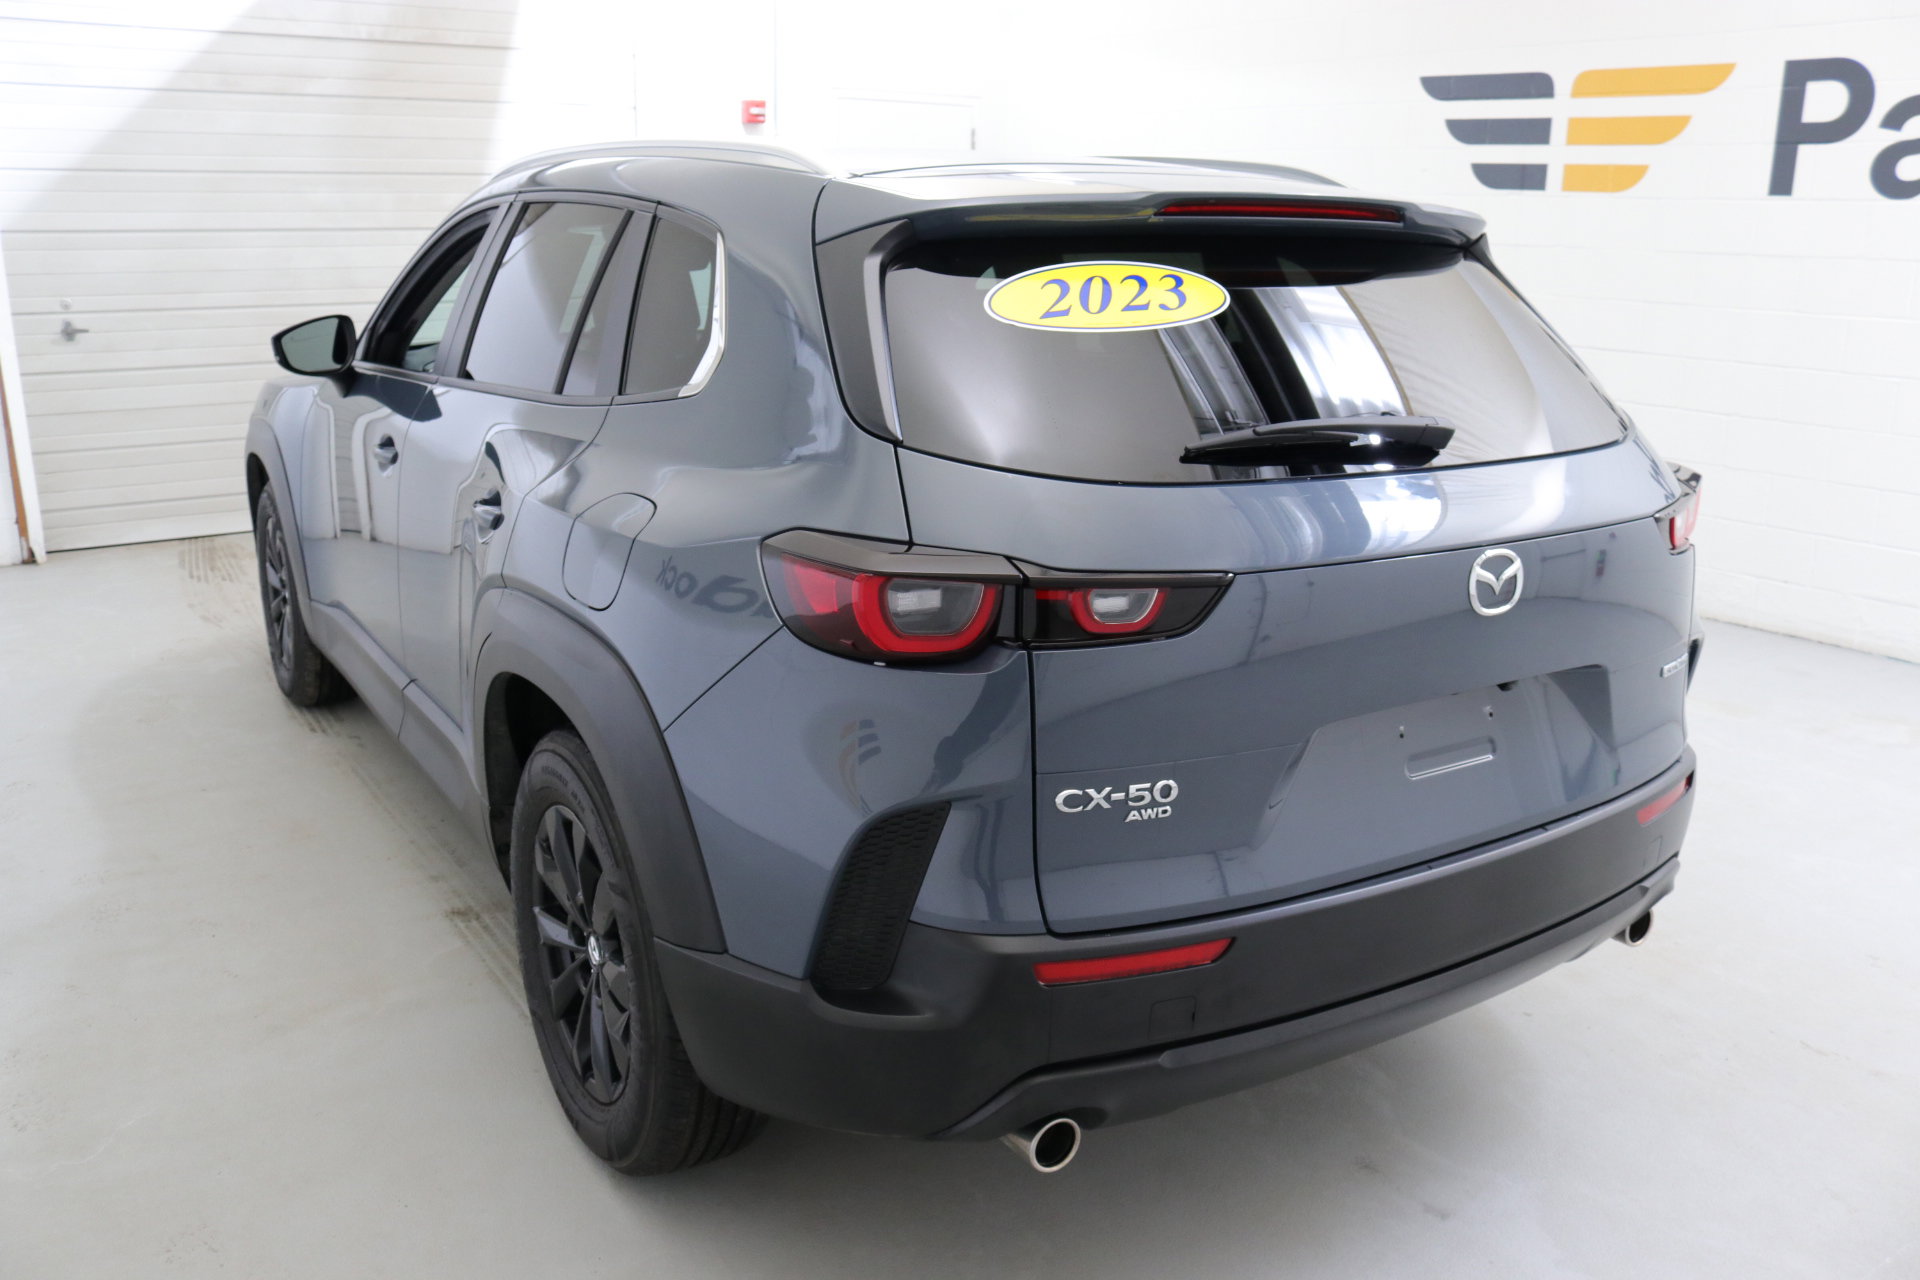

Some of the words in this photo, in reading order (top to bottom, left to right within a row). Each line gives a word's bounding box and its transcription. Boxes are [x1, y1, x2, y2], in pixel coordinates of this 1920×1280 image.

[1039, 273, 1187, 320] 2023
[1054, 779, 1179, 813] CX-50
[1124, 805, 1173, 823] AWD
